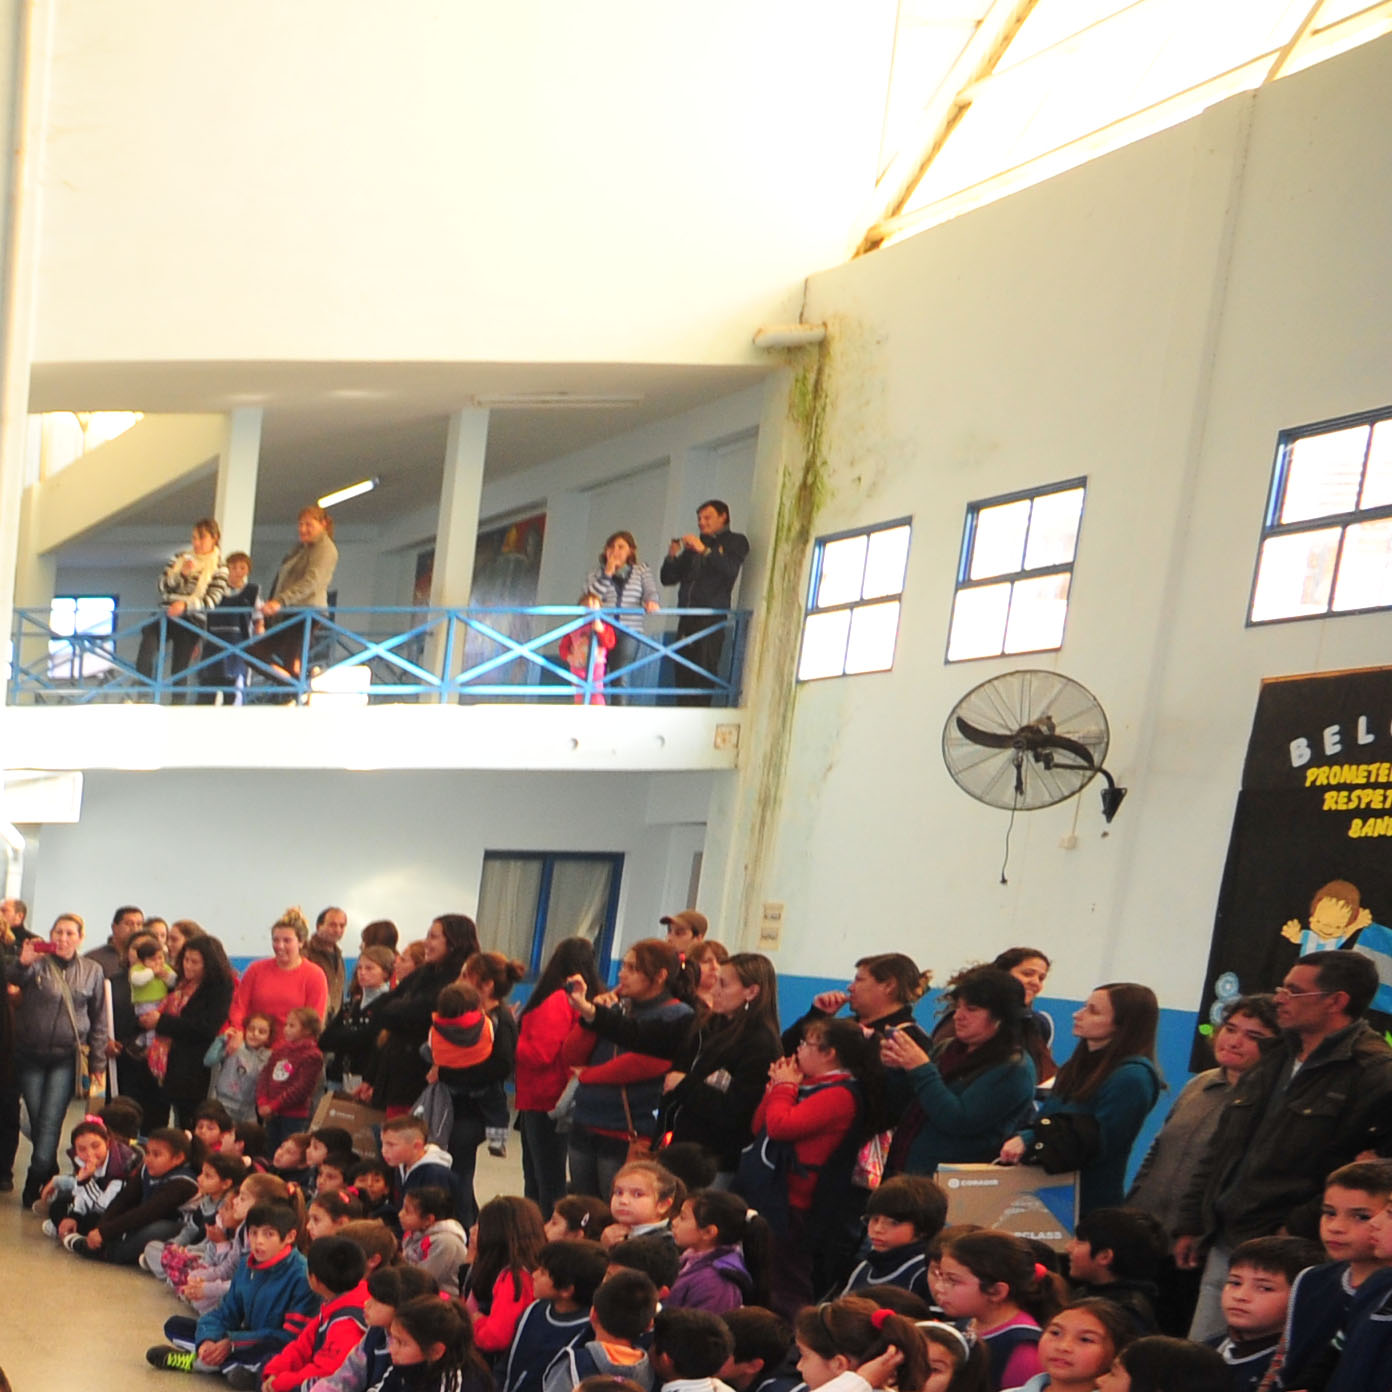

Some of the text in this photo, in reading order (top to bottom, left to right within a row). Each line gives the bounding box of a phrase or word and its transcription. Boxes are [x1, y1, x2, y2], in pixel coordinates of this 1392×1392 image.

[1289, 715, 1392, 768] BEL
[1305, 763, 1392, 788] PROMETE
[1348, 816, 1392, 838] BAN
